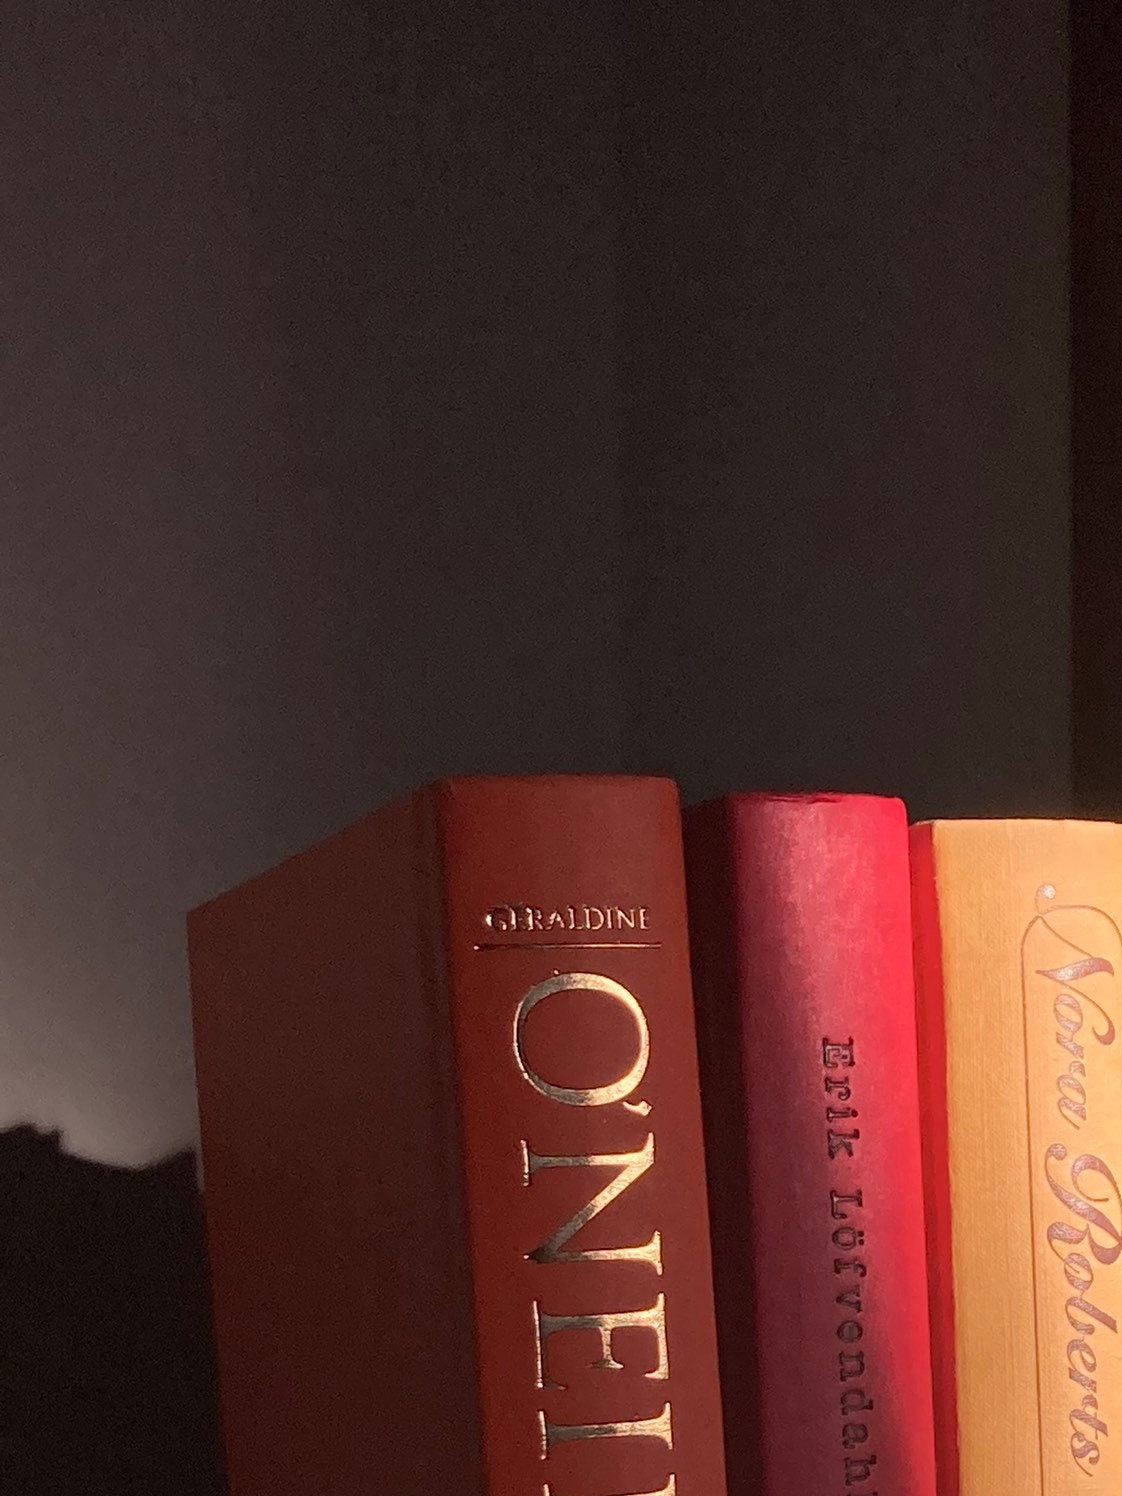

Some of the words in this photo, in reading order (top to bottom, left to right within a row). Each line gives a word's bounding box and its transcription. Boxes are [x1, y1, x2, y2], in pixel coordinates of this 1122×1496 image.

[484, 903, 651, 931] GERALDINE
[1033, 882, 1117, 1131] Nora
[822, 1036, 861, 1160] Erik
